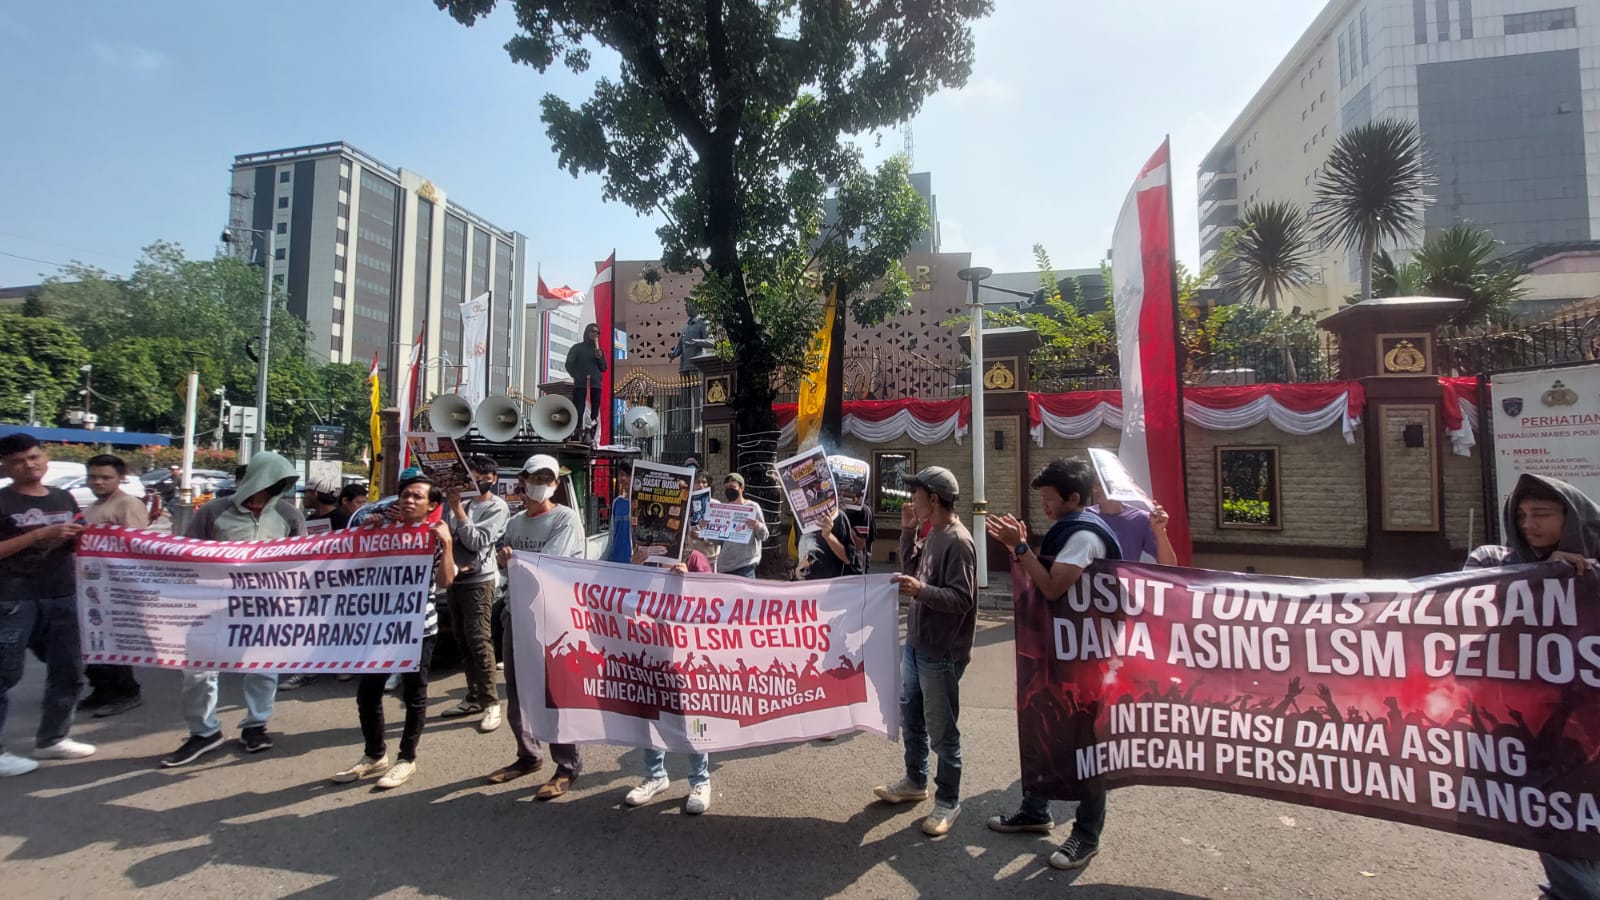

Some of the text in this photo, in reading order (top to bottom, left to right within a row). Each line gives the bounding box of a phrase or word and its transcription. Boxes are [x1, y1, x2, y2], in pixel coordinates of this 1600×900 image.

[80, 532, 430, 560] SUARA RAKYAT UNTUK KEDAULATAN NEGARA!
[228, 565, 427, 590] MEMINTA PEMERINTAH
[228, 594, 331, 617] PERKETAT
[335, 591, 423, 616] REGULASI
[573, 582, 818, 626] USUT TUNTAS ALIRAN
[1067, 572, 1578, 627] USUT TUNTAS ALIRAN
[228, 622, 372, 647] TRANSPARANSI
[372, 621, 418, 645] LSM.
[570, 607, 831, 652] DANA ASING LSM CELIOS
[1053, 616, 1600, 688] DANA ASING LSM CELIOS
[583, 677, 826, 716] MEMECAH PERSATUAN BANGSA
[606, 659, 797, 697] INTERVENSI DANA ASING
[1110, 702, 1527, 777] INTERVENSI DANA ASING
[1075, 738, 1600, 833] MEMECAH PERSATUAN BANGSA
